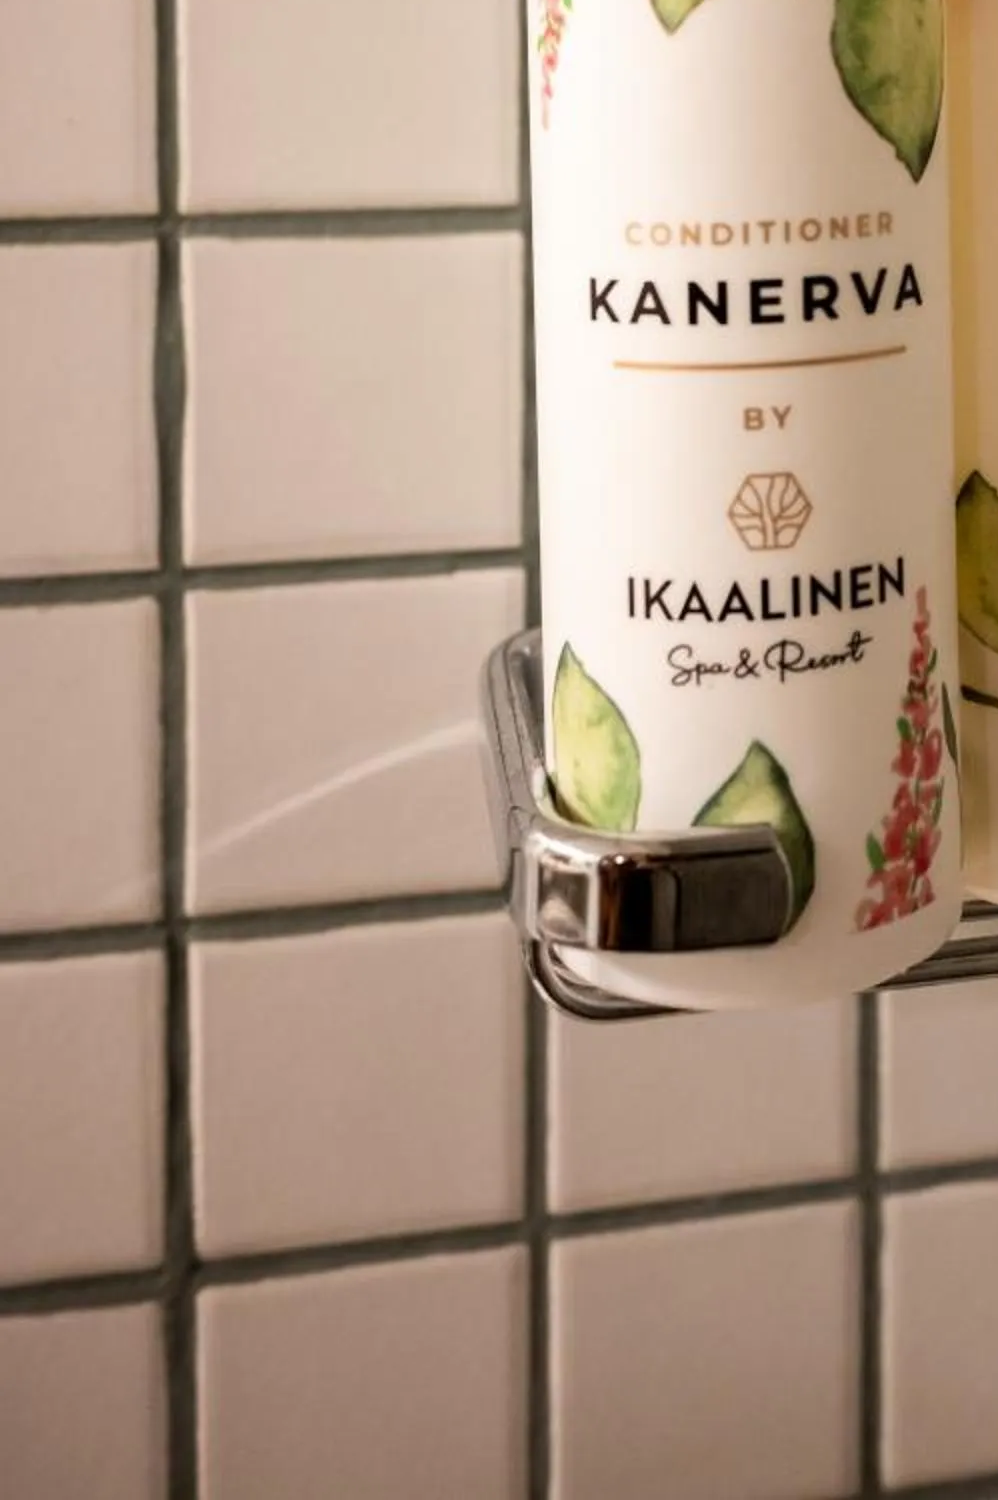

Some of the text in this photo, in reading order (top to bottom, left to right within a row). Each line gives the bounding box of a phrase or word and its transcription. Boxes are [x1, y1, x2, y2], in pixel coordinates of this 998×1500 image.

[624, 211, 894, 247] CONDITIONER
[588, 262, 924, 325] KANERVA
[743, 404, 793, 431] BY
[627, 556, 905, 623] IKAALINEN
[667, 630, 874, 687] Spa & Resort
